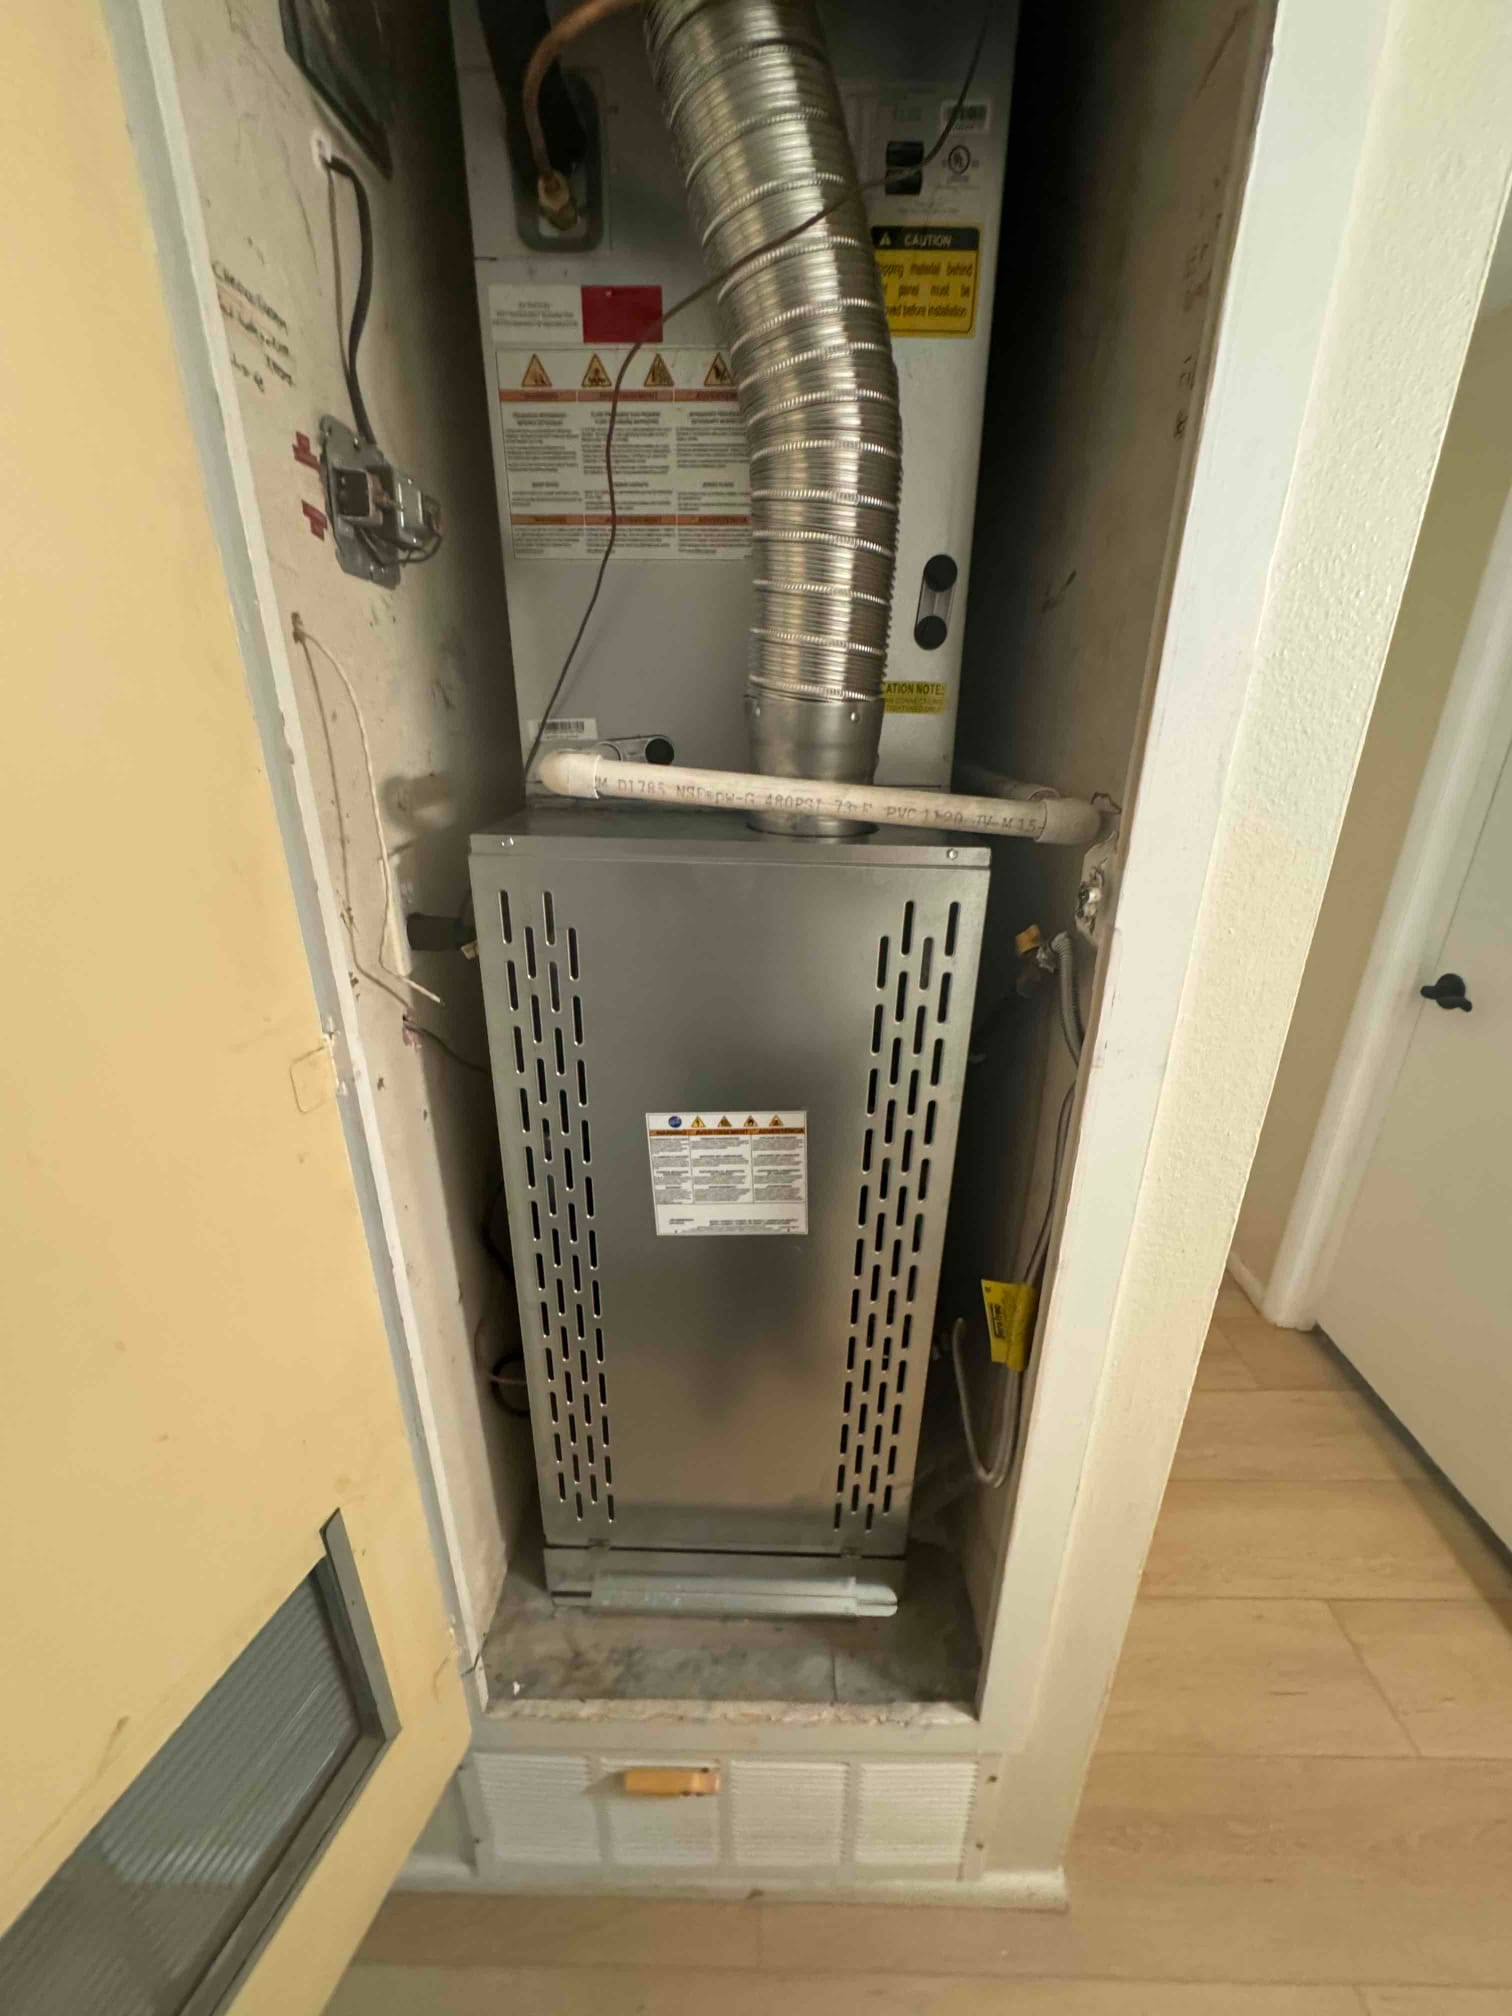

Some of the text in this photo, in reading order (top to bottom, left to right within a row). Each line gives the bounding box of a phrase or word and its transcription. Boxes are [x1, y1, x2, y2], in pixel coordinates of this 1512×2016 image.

[904, 234, 952, 248] CAUTION
[883, 682, 914, 695] ATION
[617, 778, 666, 796] D1785
